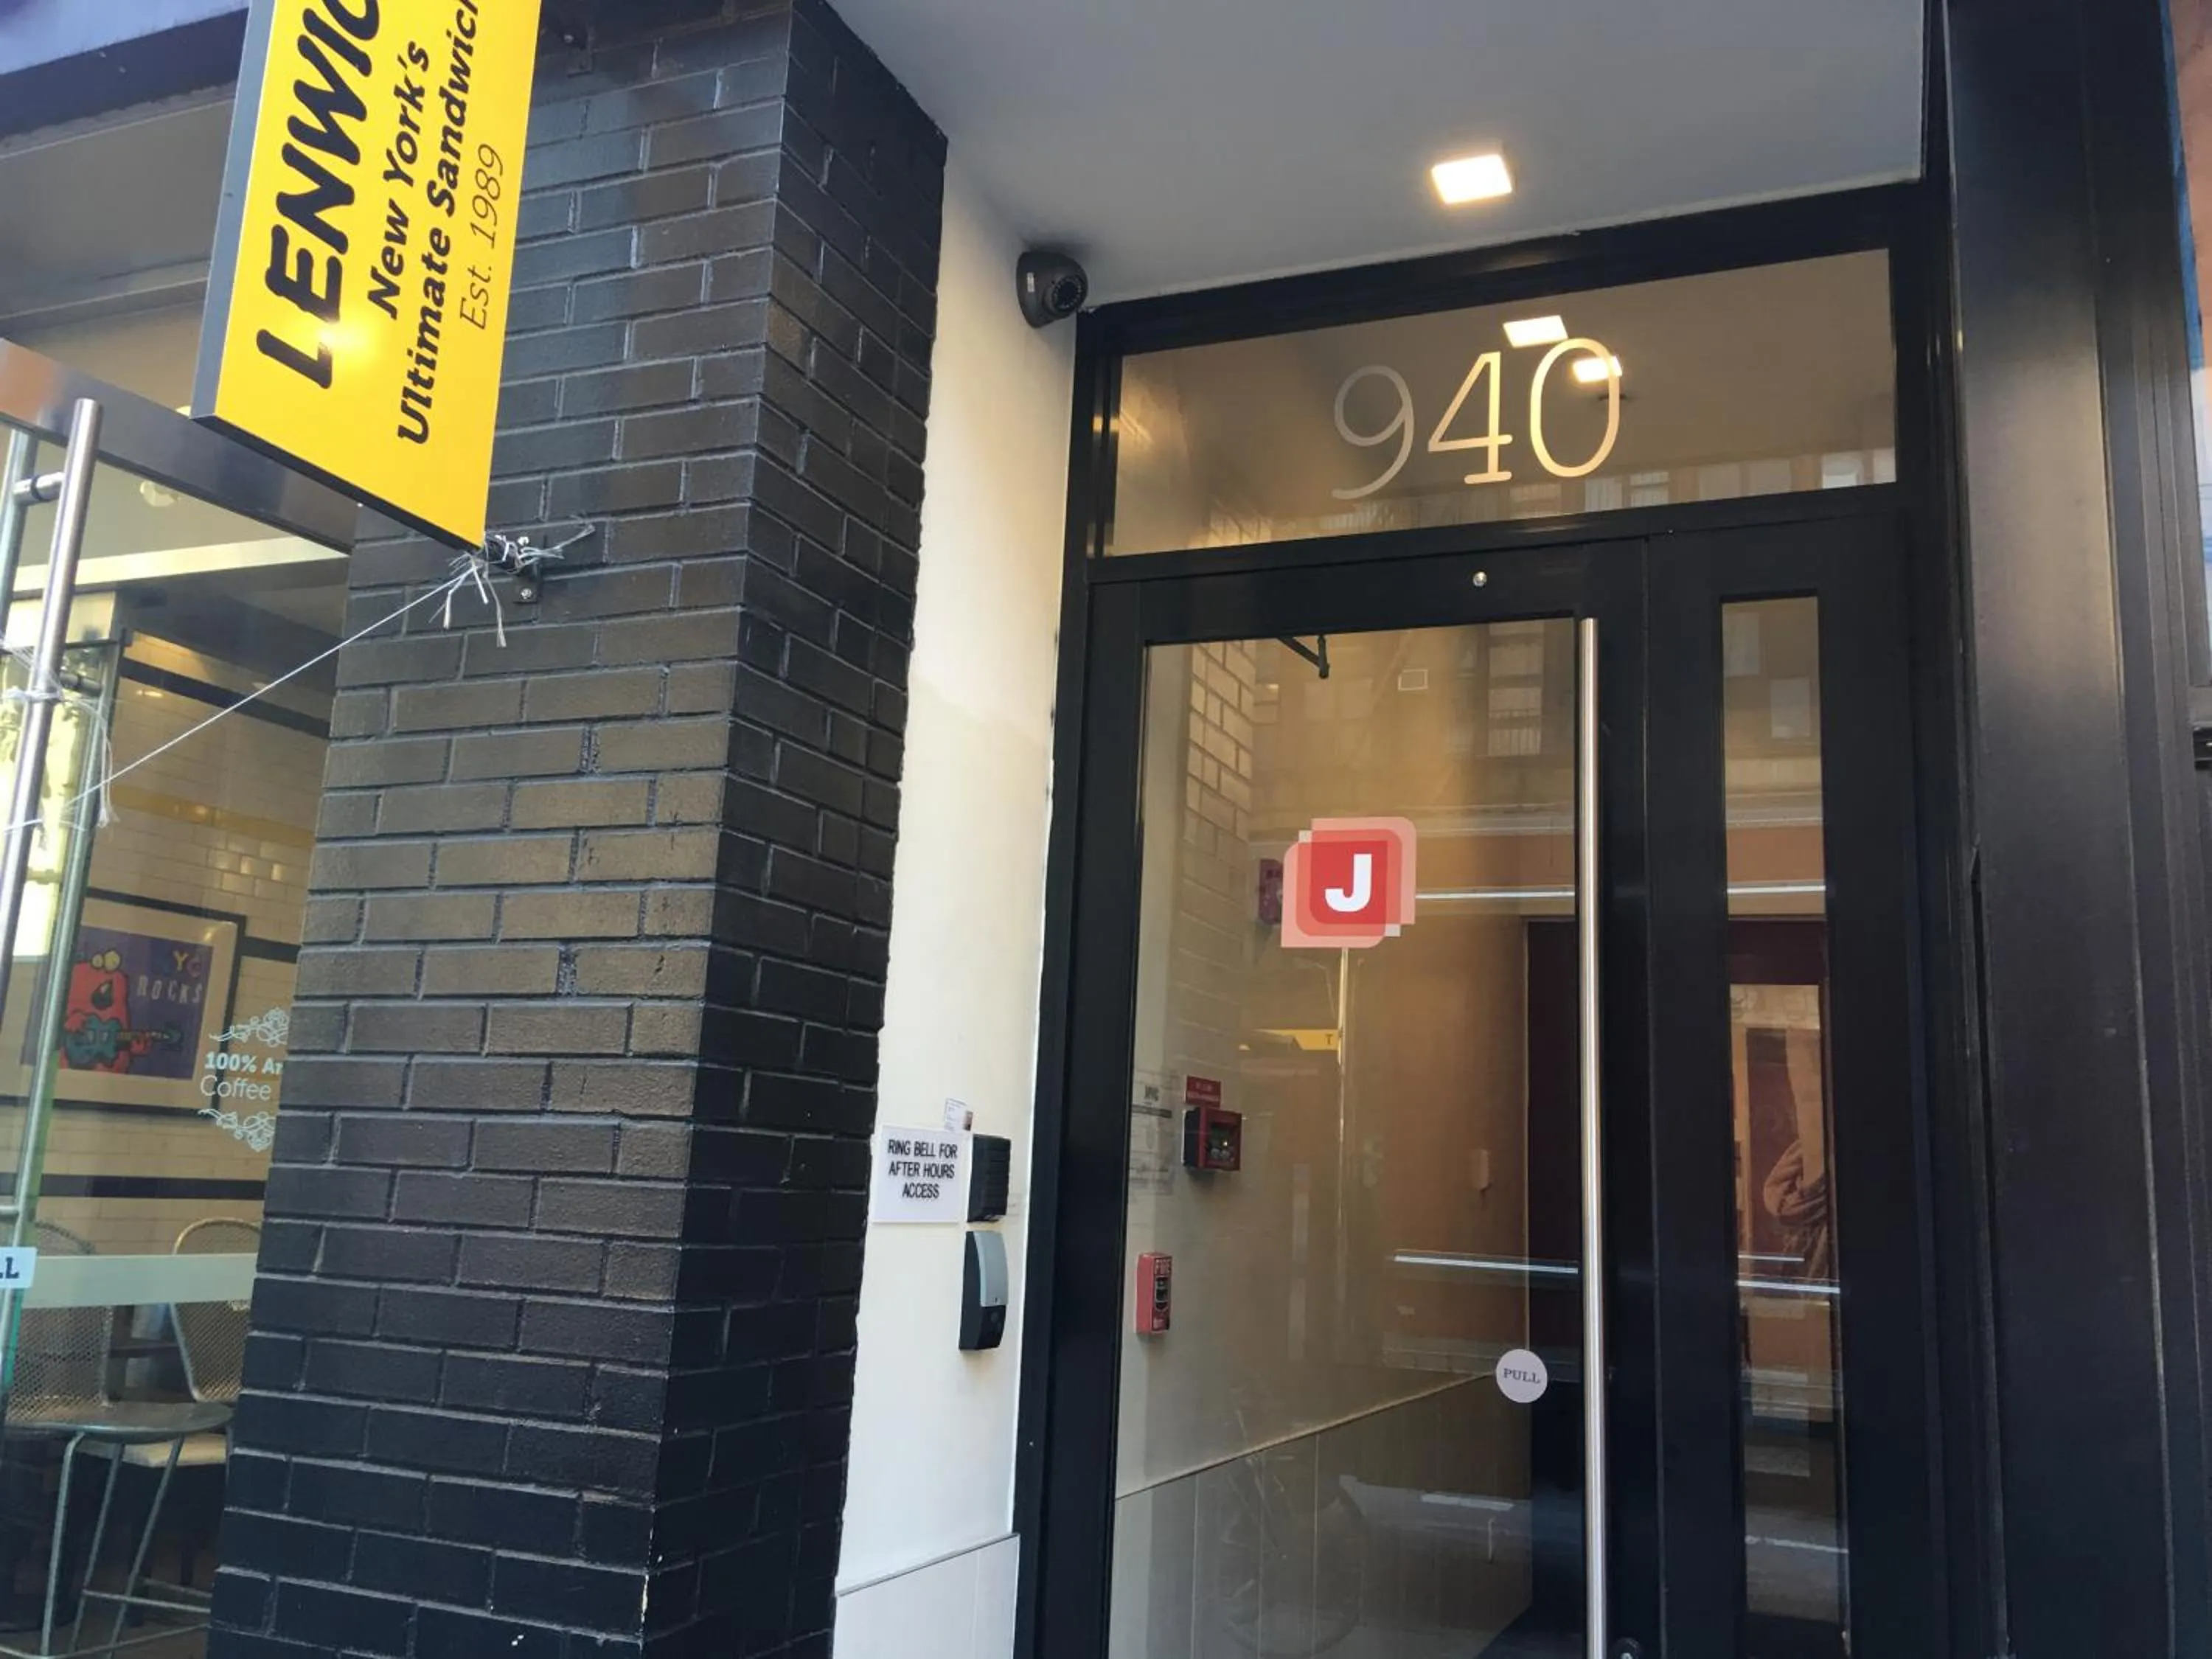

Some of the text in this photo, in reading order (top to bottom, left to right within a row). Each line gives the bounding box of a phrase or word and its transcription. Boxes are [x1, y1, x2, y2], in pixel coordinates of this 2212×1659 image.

[367, 41, 430, 320] New York's
[459, 143, 504, 330] Est. 1989
[397, 226, 451, 445] Ultimate
[1331, 337, 1621, 500] 940
[1324, 853, 1372, 913] J
[204, 1051, 257, 1074] 100%
[200, 1074, 272, 1102] Coffee
[887, 1139, 958, 1158] RING BELL FOR
[888, 1161, 955, 1179] AFTER HOURS
[902, 1182, 940, 1198] ACCESS
[1503, 1368, 1541, 1385] PULL
